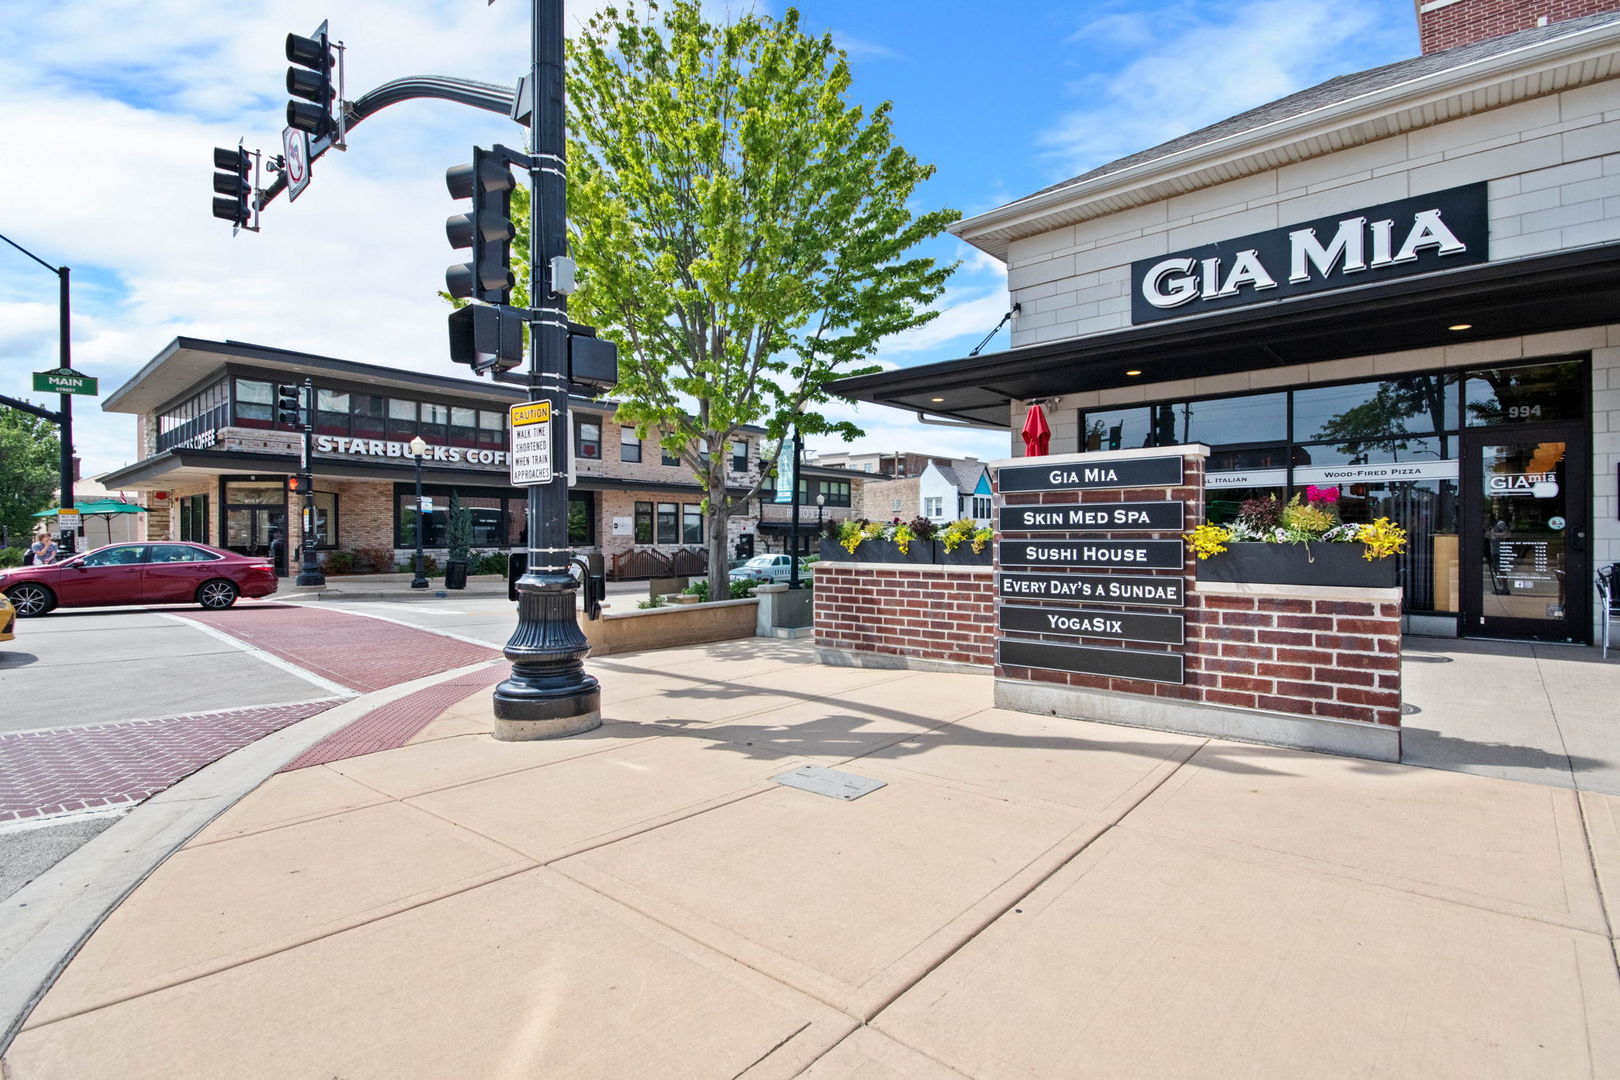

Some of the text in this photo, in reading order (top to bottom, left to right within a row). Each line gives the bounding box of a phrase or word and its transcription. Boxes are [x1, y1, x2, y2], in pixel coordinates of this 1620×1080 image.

[1142, 208, 1466, 308] GIA MIA
[48, 377, 83, 386] MAIN
[514, 408, 547, 421] CAUTION
[1508, 405, 1541, 418] 994
[516, 426, 546, 439] WALK TIME
[317, 435, 511, 465] STARBUCKS COF
[515, 440, 547, 453] SHORTENED
[515, 454, 548, 466] WHEN TRAIN
[514, 468, 550, 480] APPROACHES
[1049, 468, 1118, 484] GIA MIA
[1324, 468, 1422, 478] WOOD-FIRED PIZZA
[1490, 475, 1531, 489] GIA
[1023, 509, 1150, 525] SKIN MED SPA
[1026, 546, 1148, 562] SUSHI HOUSE
[1003, 578, 1177, 600] EVERY DAY'S A SUNDAE
[1047, 614, 1122, 633] YOGASIX
